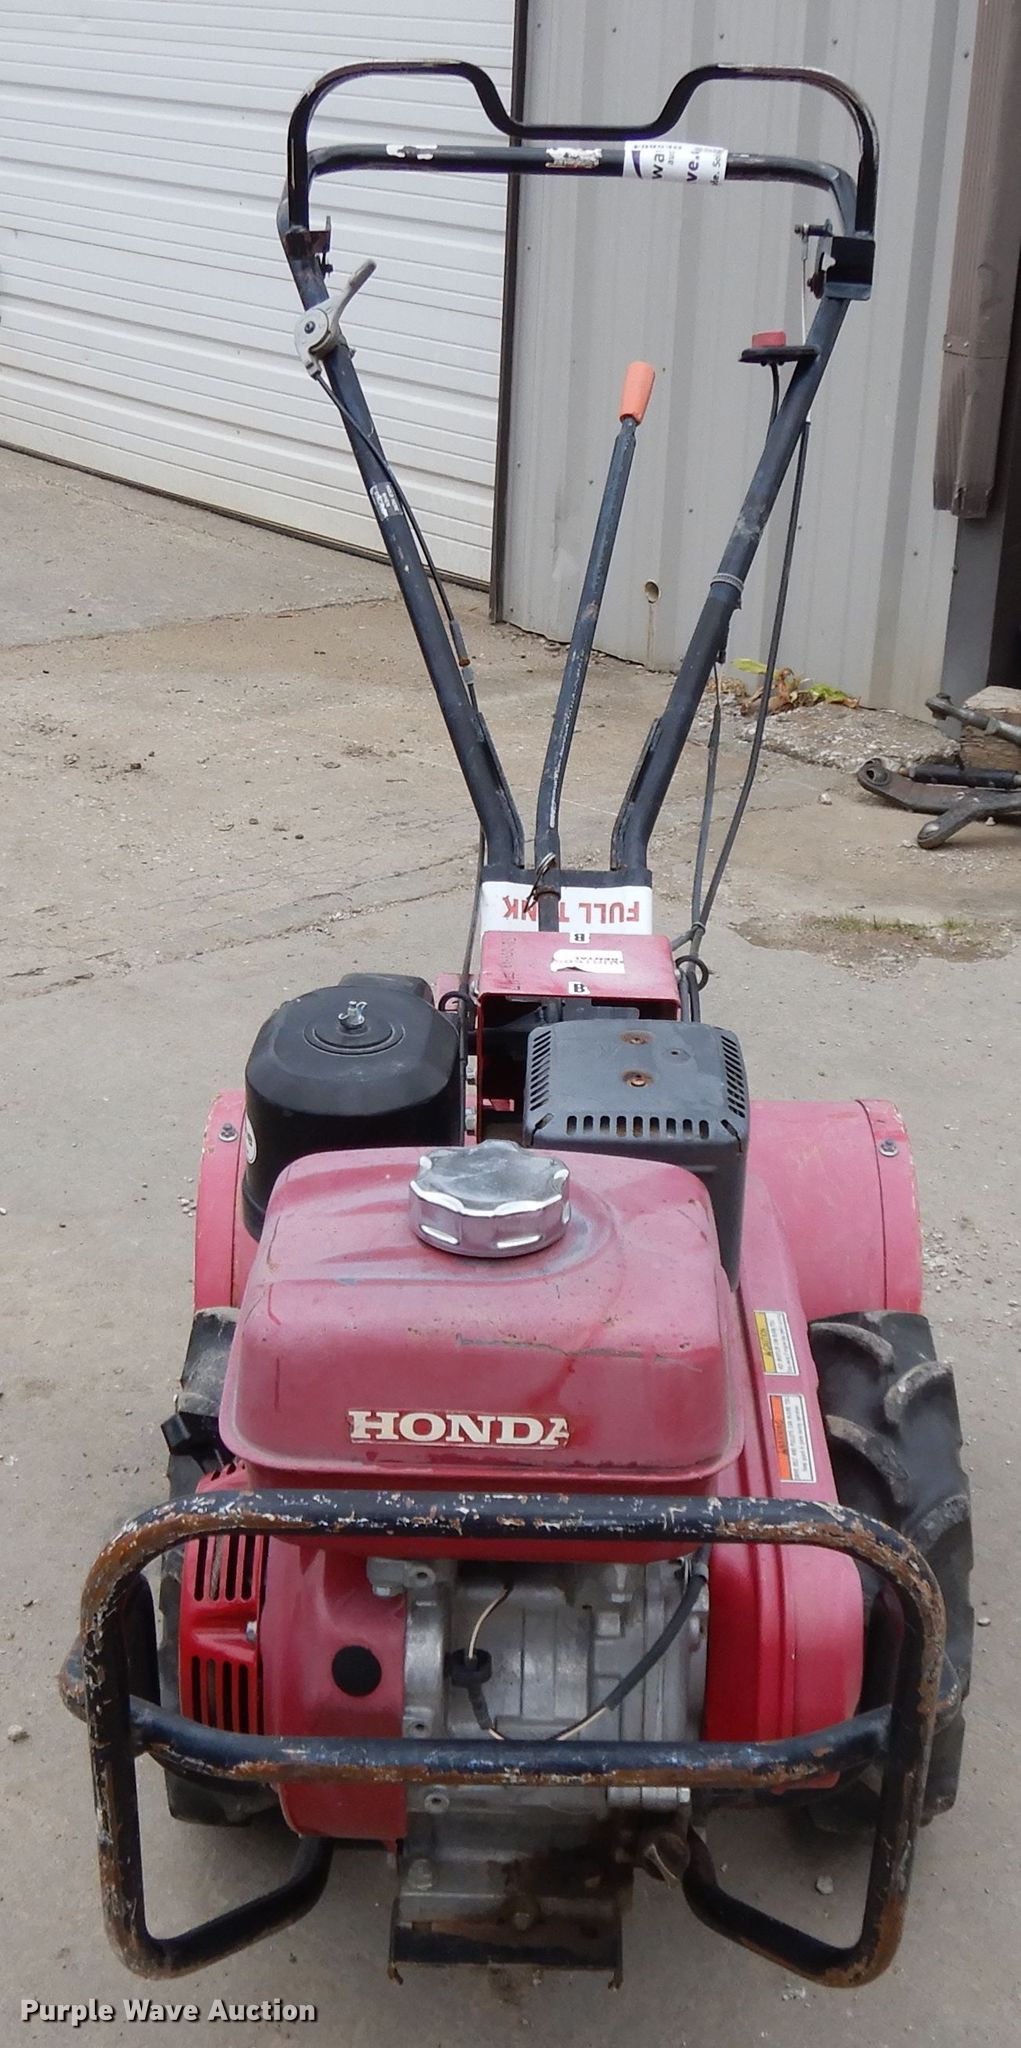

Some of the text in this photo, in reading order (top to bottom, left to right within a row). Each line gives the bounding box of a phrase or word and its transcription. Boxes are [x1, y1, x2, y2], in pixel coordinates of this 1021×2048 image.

[502, 895, 640, 924] FULL TNK
[573, 983, 585, 992] B
[348, 1411, 569, 1446] HONDA
